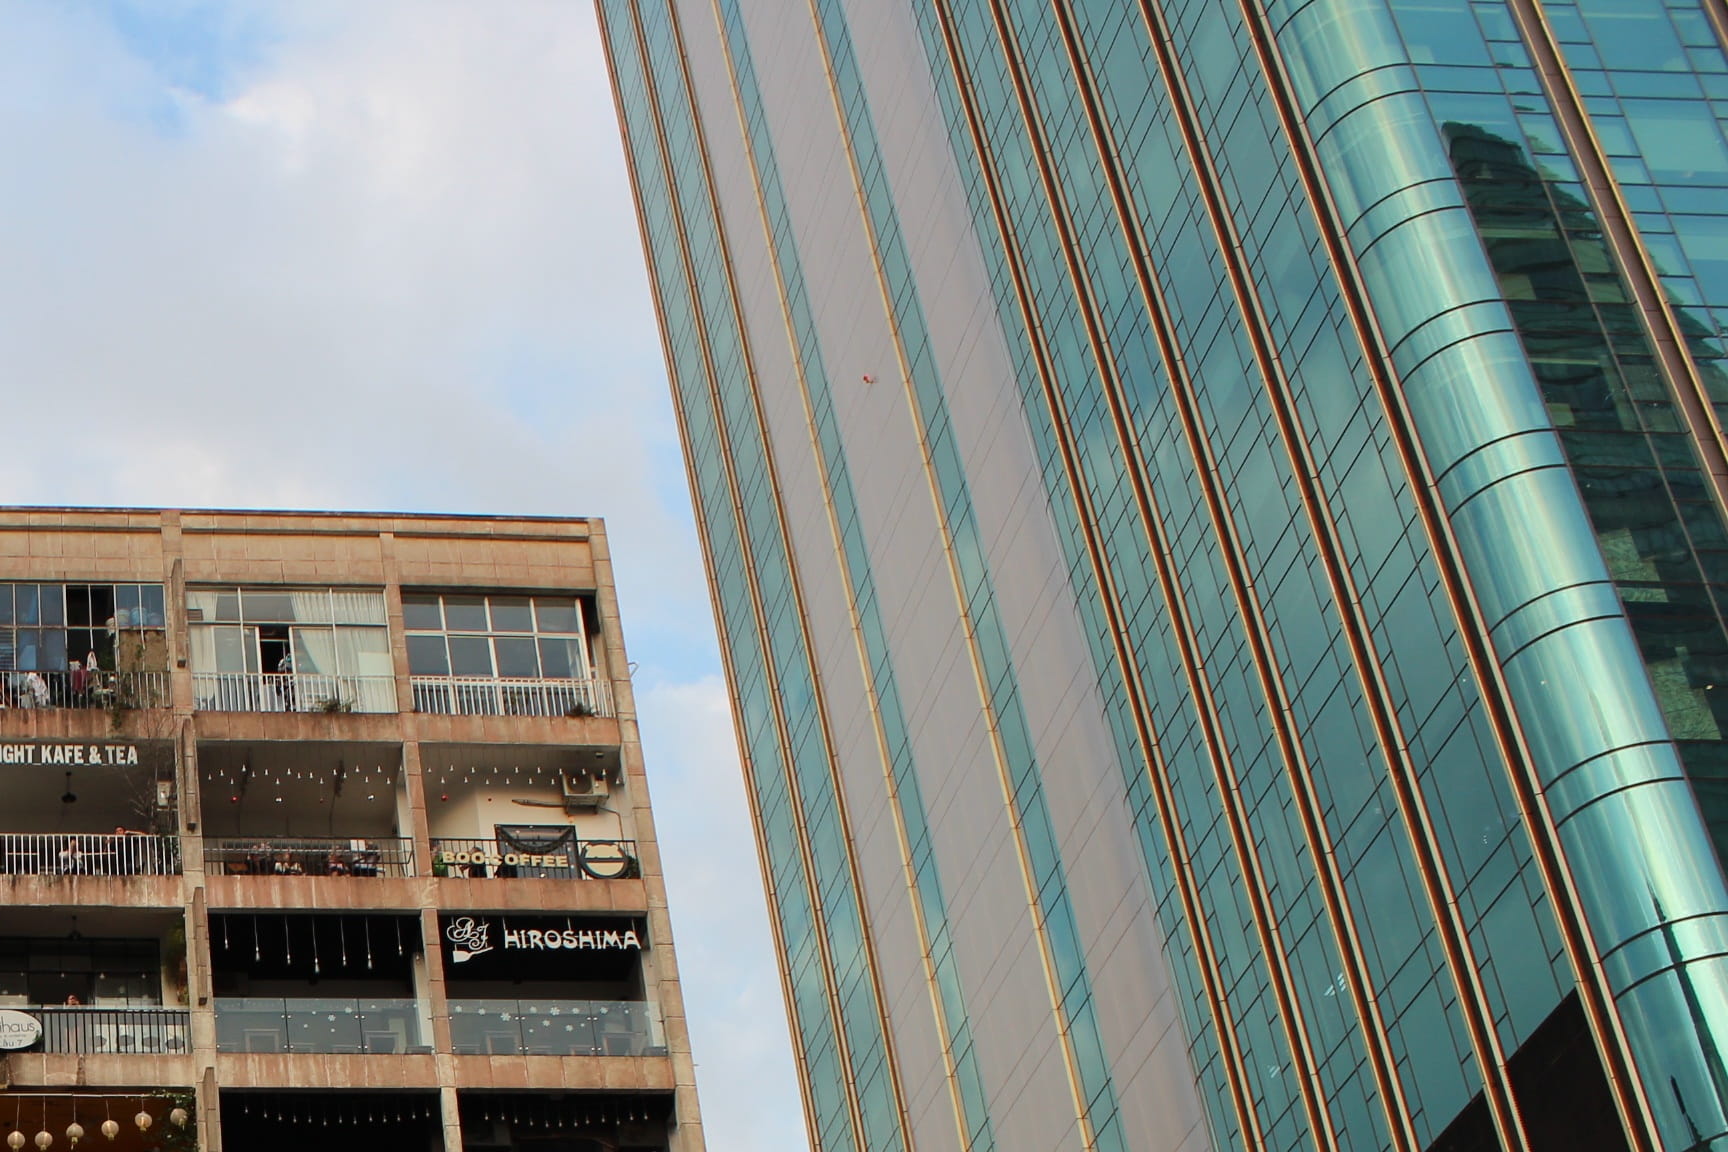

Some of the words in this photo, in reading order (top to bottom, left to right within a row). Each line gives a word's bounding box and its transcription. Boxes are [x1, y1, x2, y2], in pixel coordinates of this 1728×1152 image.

[41, 744, 84, 764] KAFE
[88, 746, 101, 764] &
[105, 745, 138, 764] TEA
[442, 851, 485, 865] BOO
[487, 853, 568, 868] COFFEE
[504, 930, 642, 950] HIROSHIMA
